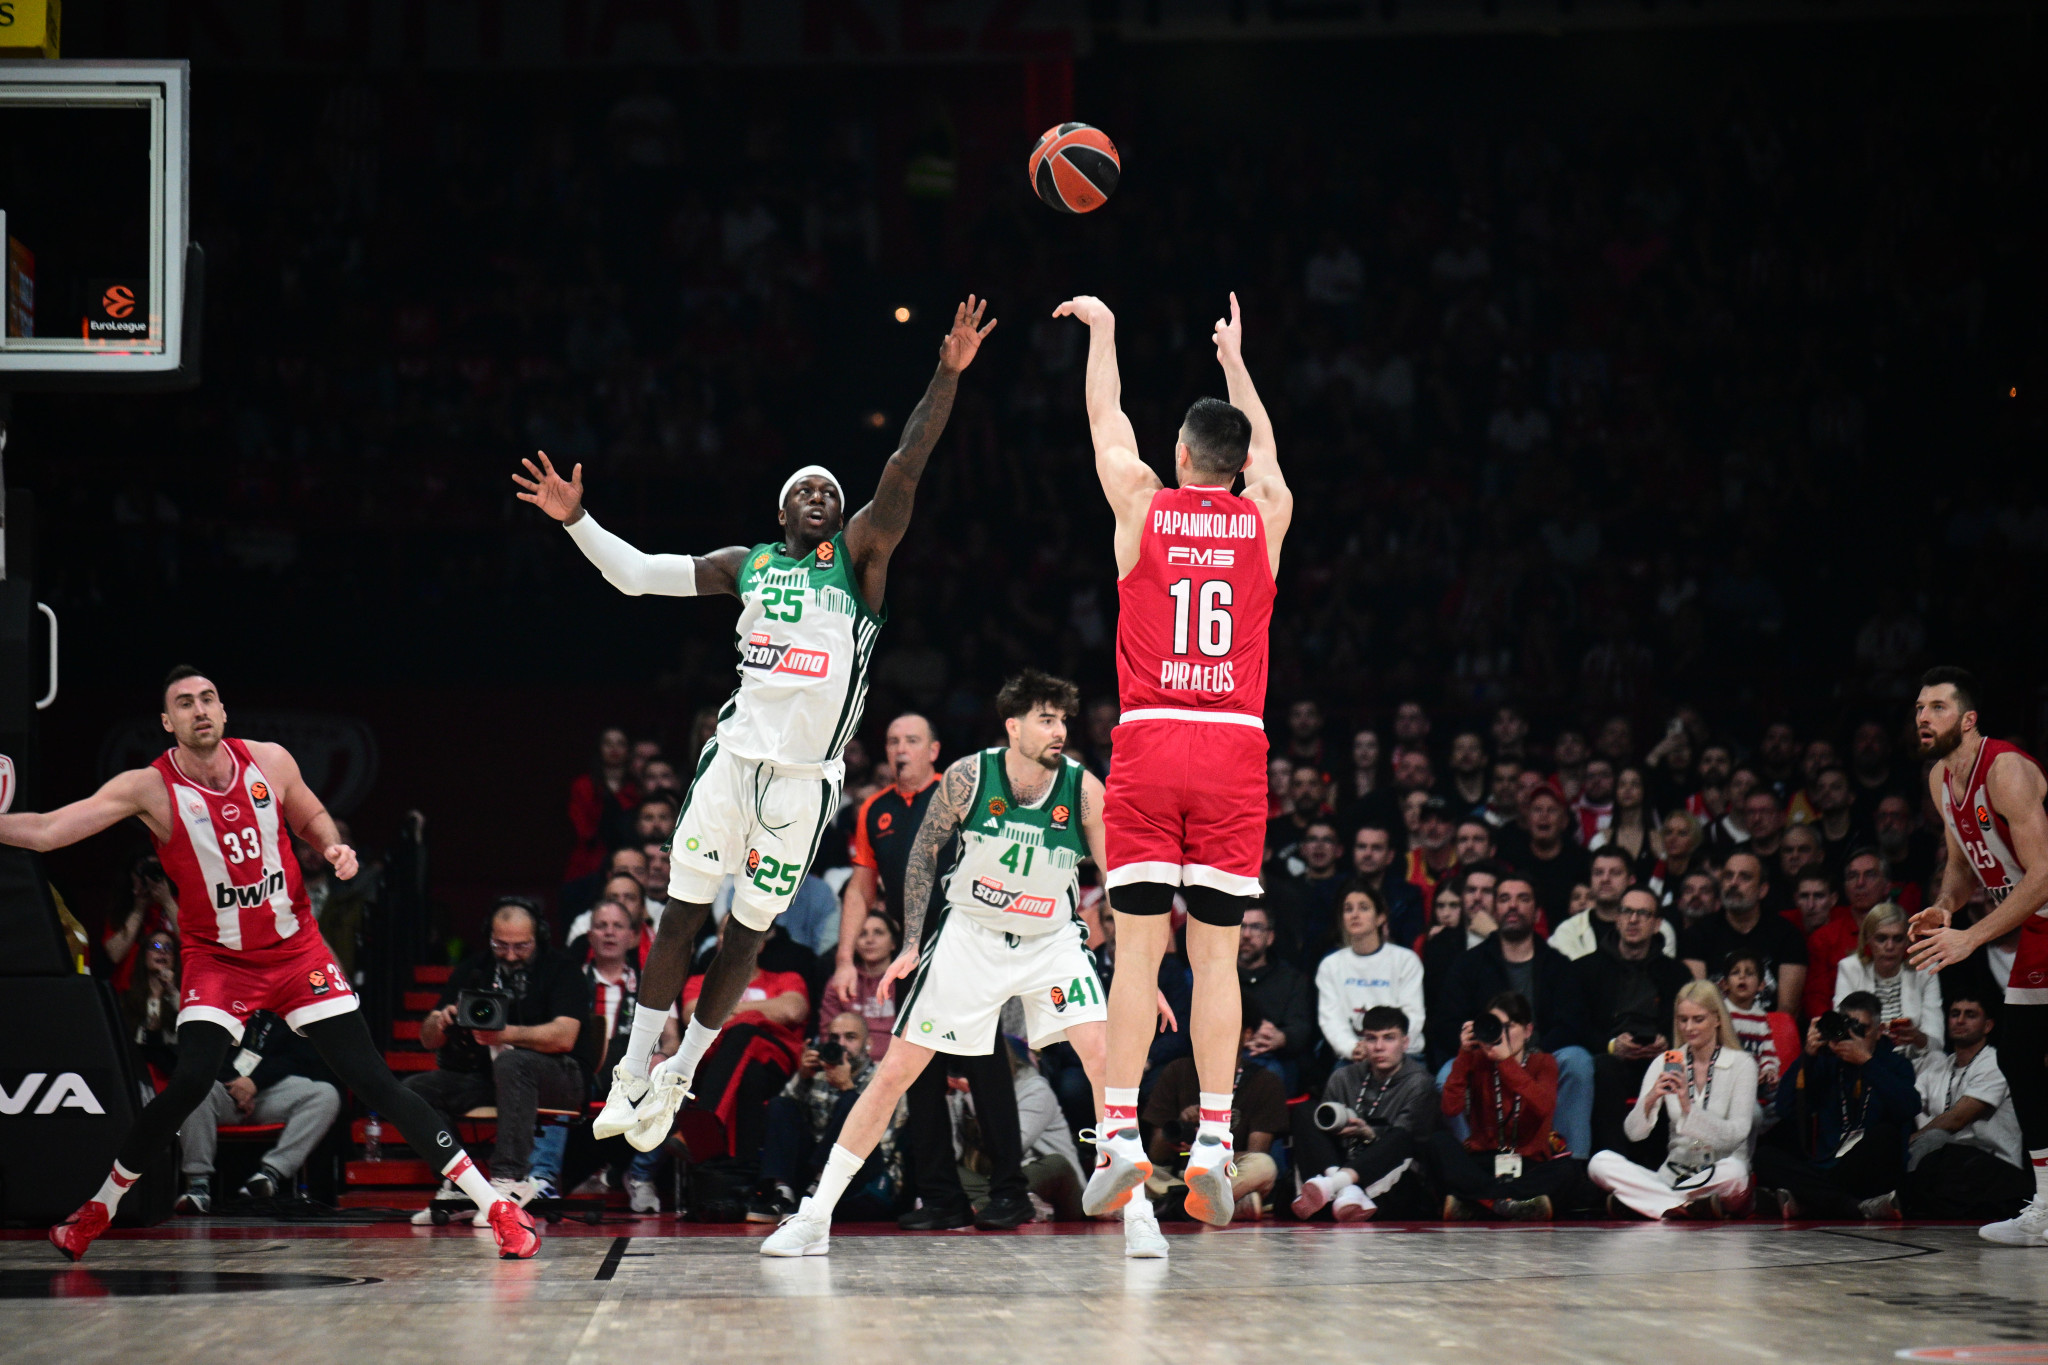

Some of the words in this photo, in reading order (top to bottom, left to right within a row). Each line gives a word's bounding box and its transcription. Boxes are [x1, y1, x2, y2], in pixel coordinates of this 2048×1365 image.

[90, 320, 147, 333] EuroLeague
[1154, 510, 1256, 539] PAPANIKOLAOU
[1168, 546, 1235, 566] FMS
[762, 587, 804, 623] 25
[1169, 578, 1233, 657] 16
[1160, 660, 1235, 693] PIRAEUS
[223, 827, 261, 865] 33
[999, 843, 1035, 876] 41
[1966, 840, 1996, 869] 25
[216, 868, 284, 909] bwin
[753, 855, 801, 896] 25
[326, 963, 351, 991] 3
[1067, 976, 1099, 1007] 41
